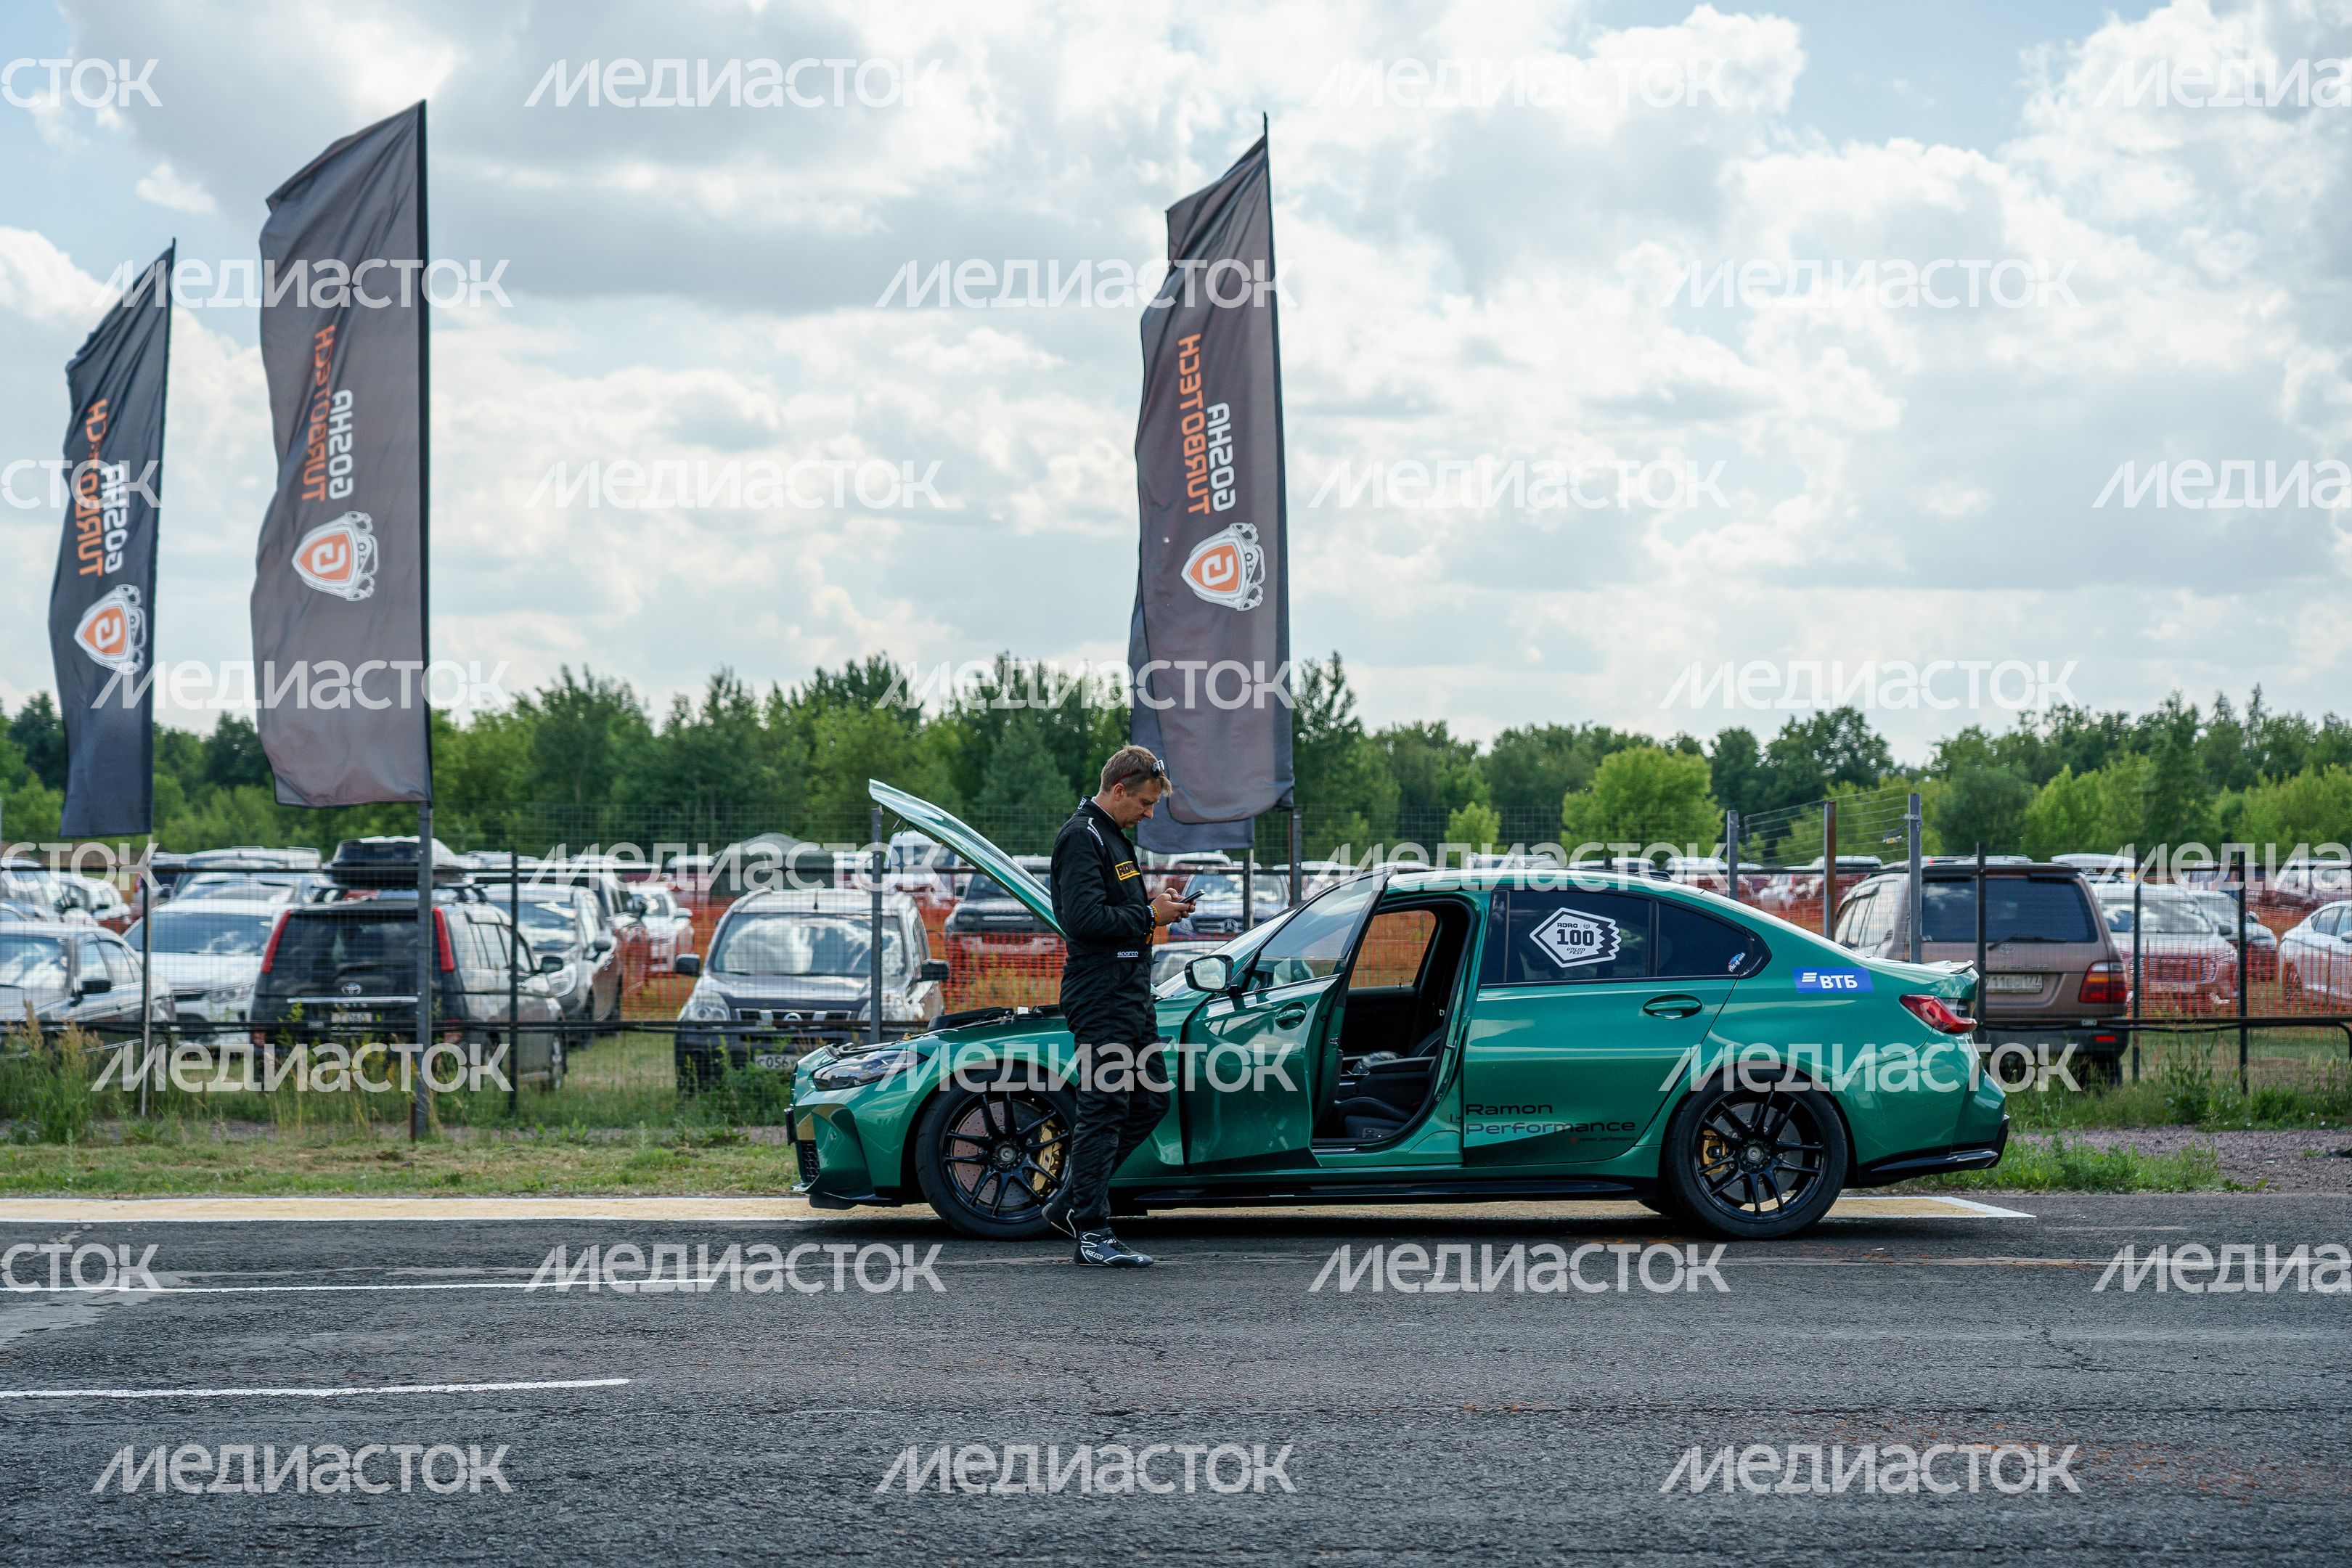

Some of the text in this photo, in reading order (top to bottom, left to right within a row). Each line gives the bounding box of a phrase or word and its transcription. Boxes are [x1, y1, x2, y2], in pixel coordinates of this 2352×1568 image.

[1557, 929, 1594, 946] 100
[1820, 975, 1858, 989] ВТБ
[1465, 1103, 1553, 1116] Ramon
[1466, 1122, 1636, 1135] Performance
